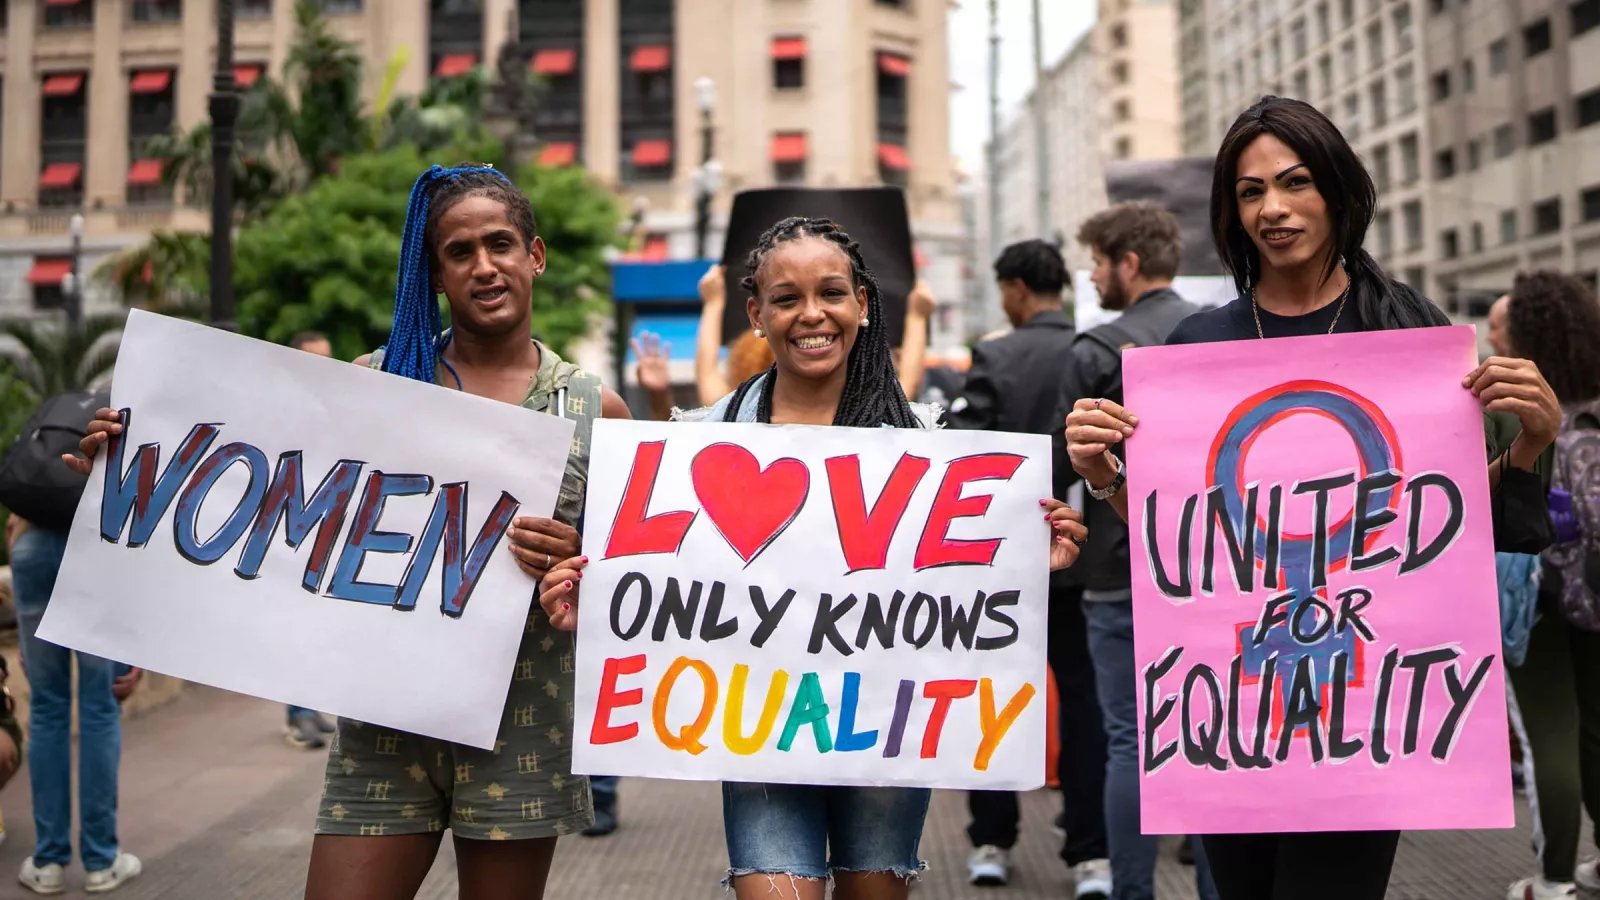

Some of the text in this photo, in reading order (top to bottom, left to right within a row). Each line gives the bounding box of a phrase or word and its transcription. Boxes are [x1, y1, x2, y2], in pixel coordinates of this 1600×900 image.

[100, 408, 520, 618] WOMEN
[1145, 472, 1465, 602] UNITED
[609, 571, 1021, 656] ONLY KNOWS
[1253, 587, 1377, 647] FOR
[590, 654, 1035, 771] EQUALITY
[1143, 644, 1495, 775] EQUALITY
